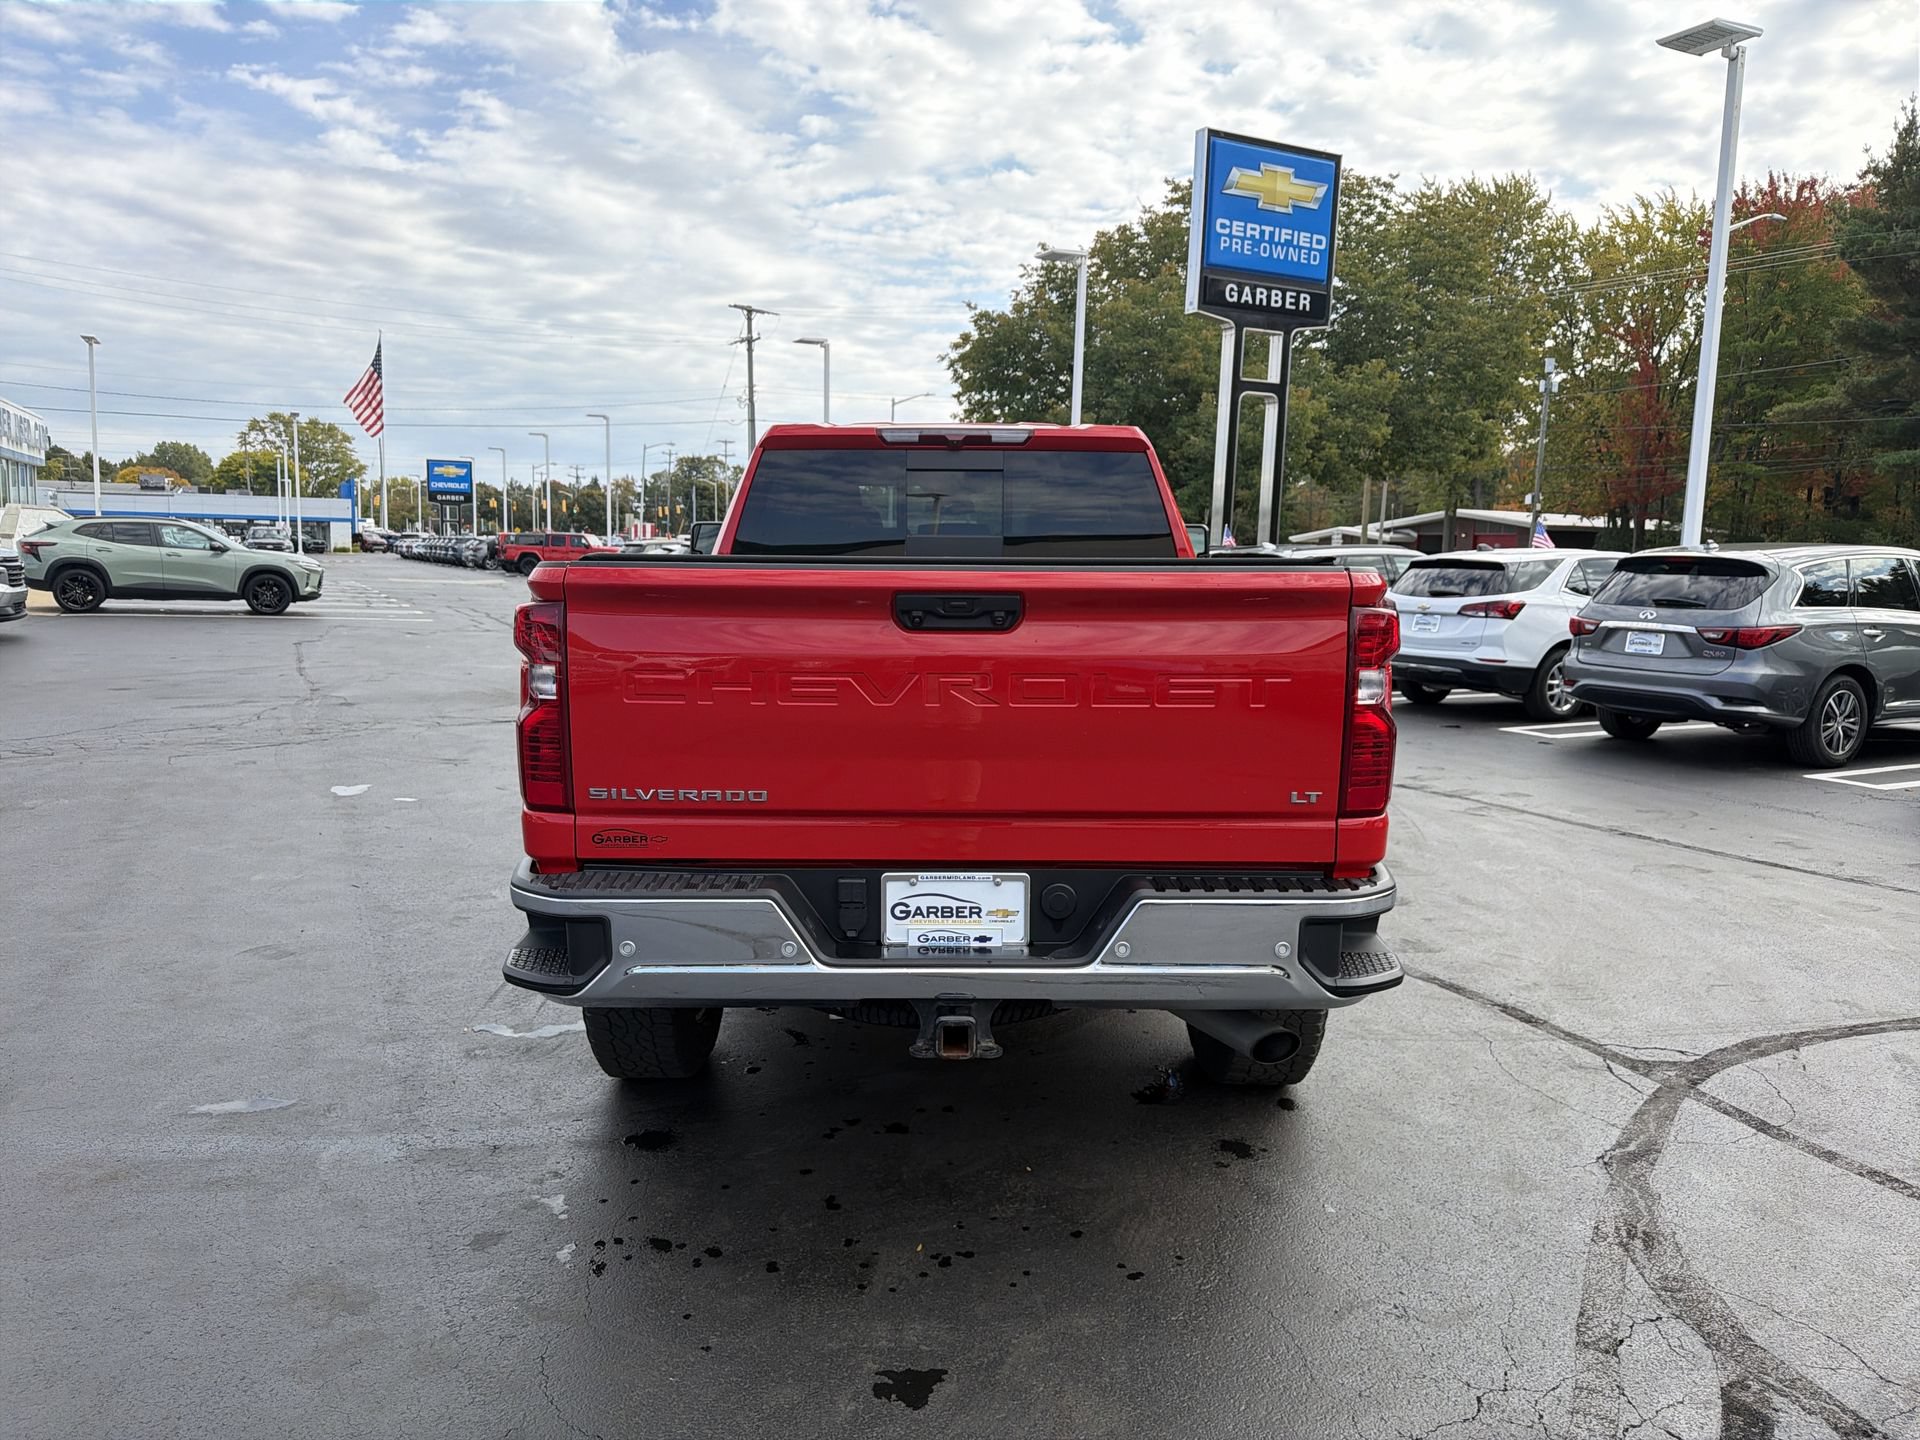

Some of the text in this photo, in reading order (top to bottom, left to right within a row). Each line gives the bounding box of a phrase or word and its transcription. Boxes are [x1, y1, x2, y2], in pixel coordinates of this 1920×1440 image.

[1215, 217, 1327, 250] CERTIFIED
[1220, 236, 1320, 265] PRE-OWNED
[1225, 283, 1311, 312] GARBER
[431, 481, 469, 489] CHEVROLET
[623, 669, 1292, 707] CHEVROLET
[588, 787, 768, 802] SILVERADO
[1290, 791, 1323, 803] LT
[592, 833, 648, 844] GARBER
[890, 901, 983, 921] GARBER
[917, 933, 971, 944] GARBER
